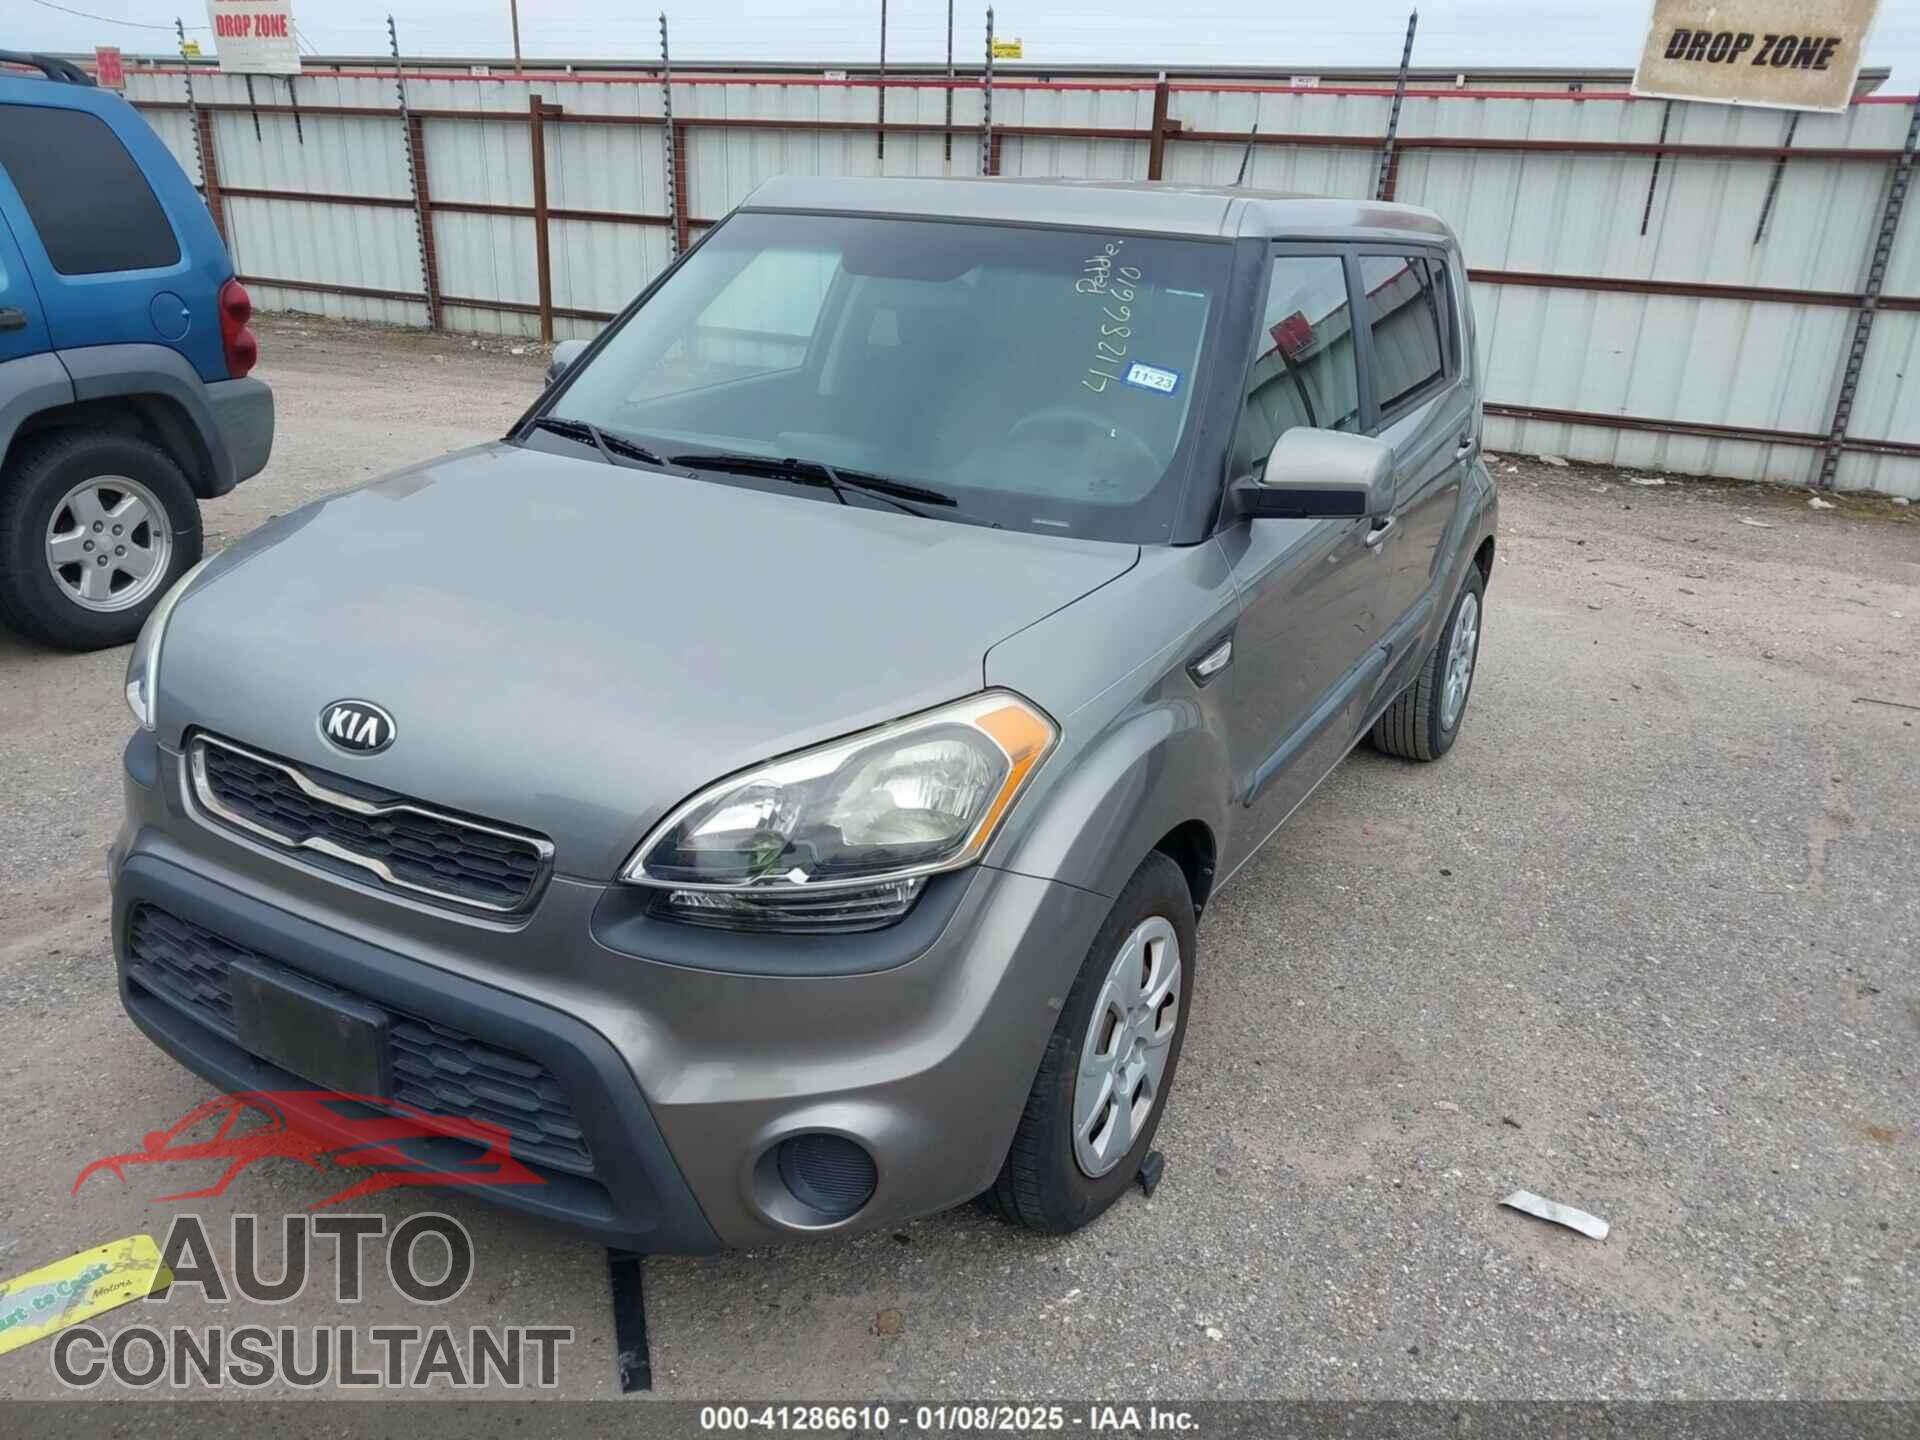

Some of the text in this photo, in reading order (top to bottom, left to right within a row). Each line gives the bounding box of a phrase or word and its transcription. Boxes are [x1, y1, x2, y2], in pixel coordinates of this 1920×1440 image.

[215, 14, 289, 37] DROP ZONE
[1663, 28, 1843, 71] DROP ZONE
[1081, 266, 1142, 393] 41286610
[327, 706, 379, 747] KIA
